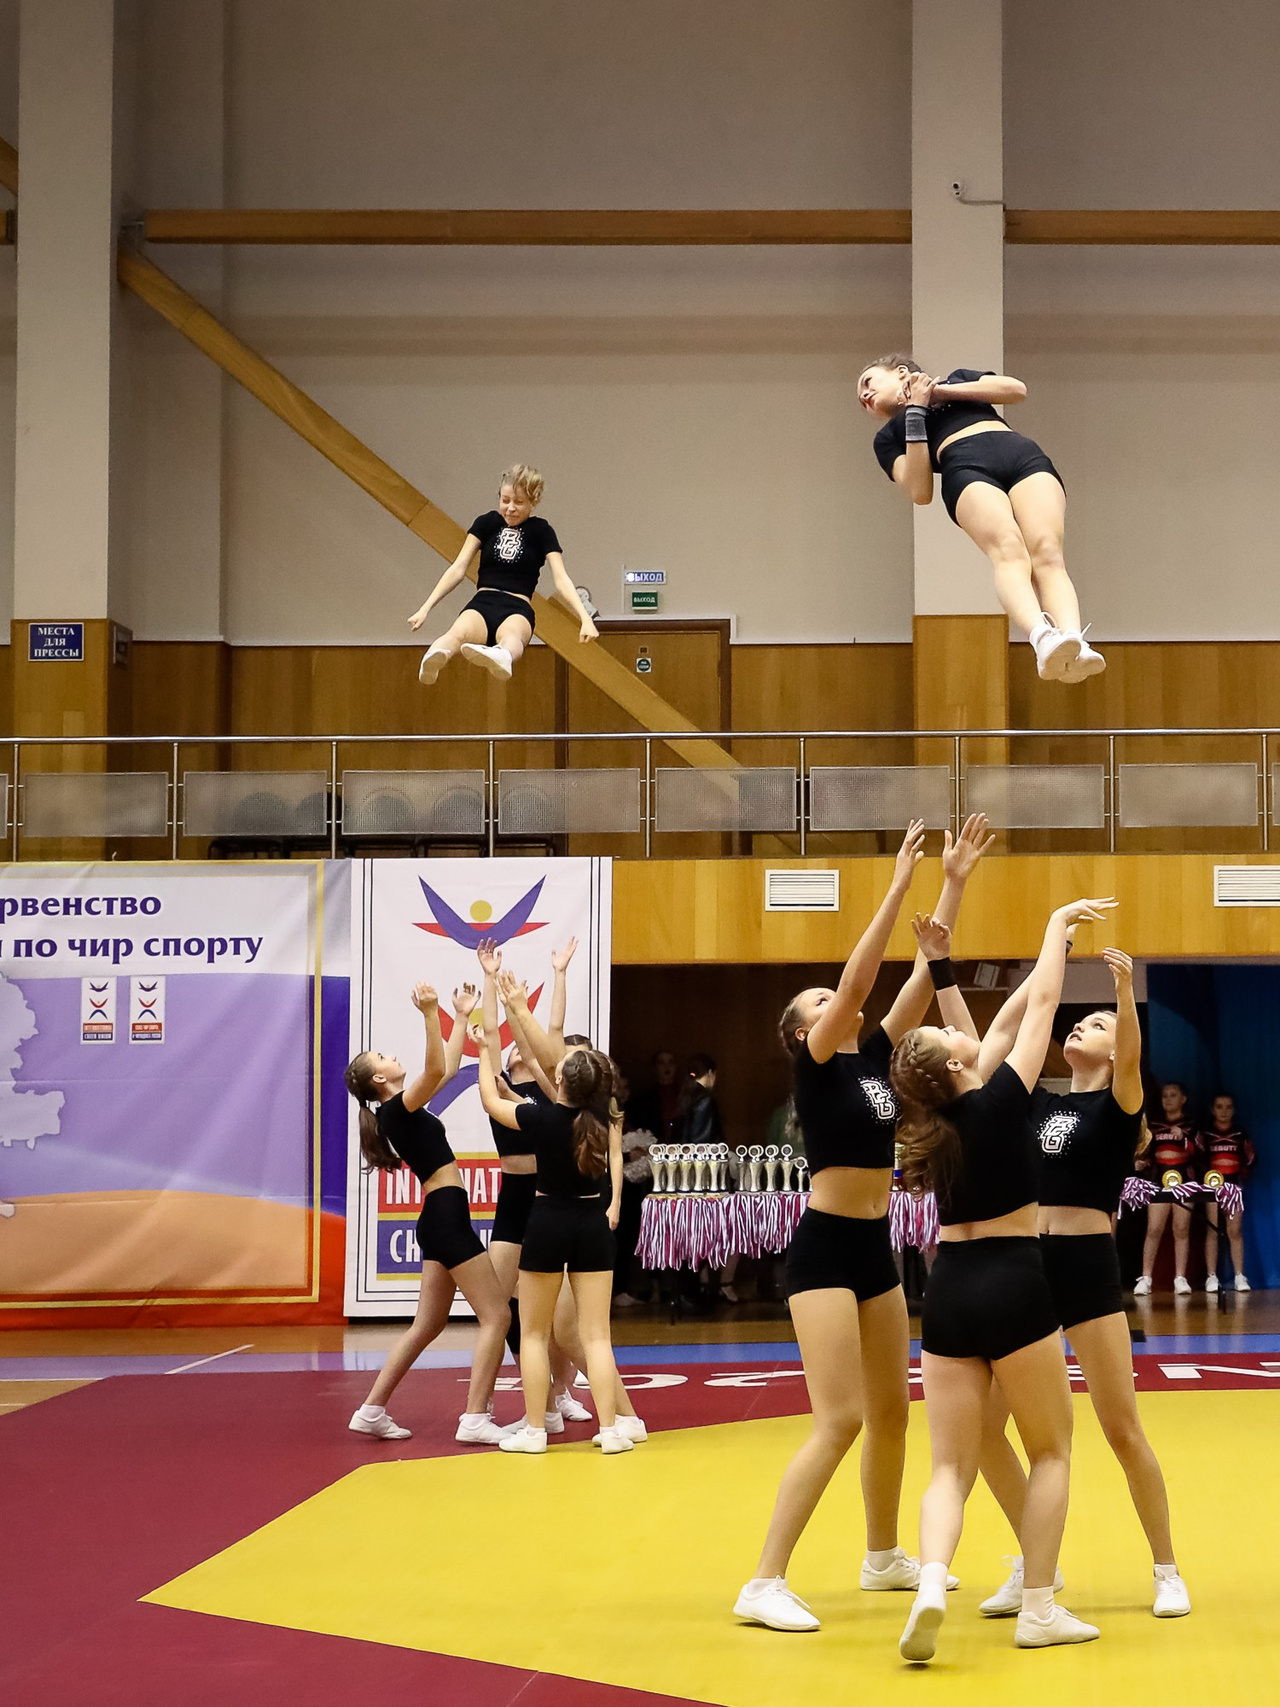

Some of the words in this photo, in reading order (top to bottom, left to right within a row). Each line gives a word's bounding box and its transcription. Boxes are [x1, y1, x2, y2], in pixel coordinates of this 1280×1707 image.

[626, 572, 663, 582] ЫХОД
[38, 627, 75, 635] МЕСТА
[43, 638, 66, 647] ДЛЯ
[34, 648, 79, 657] ПРЕССЫ
[0, 896, 162, 924] рвенство
[13, 939, 58, 958] по
[68, 937, 134, 964] чир
[143, 936, 264, 964] спорту
